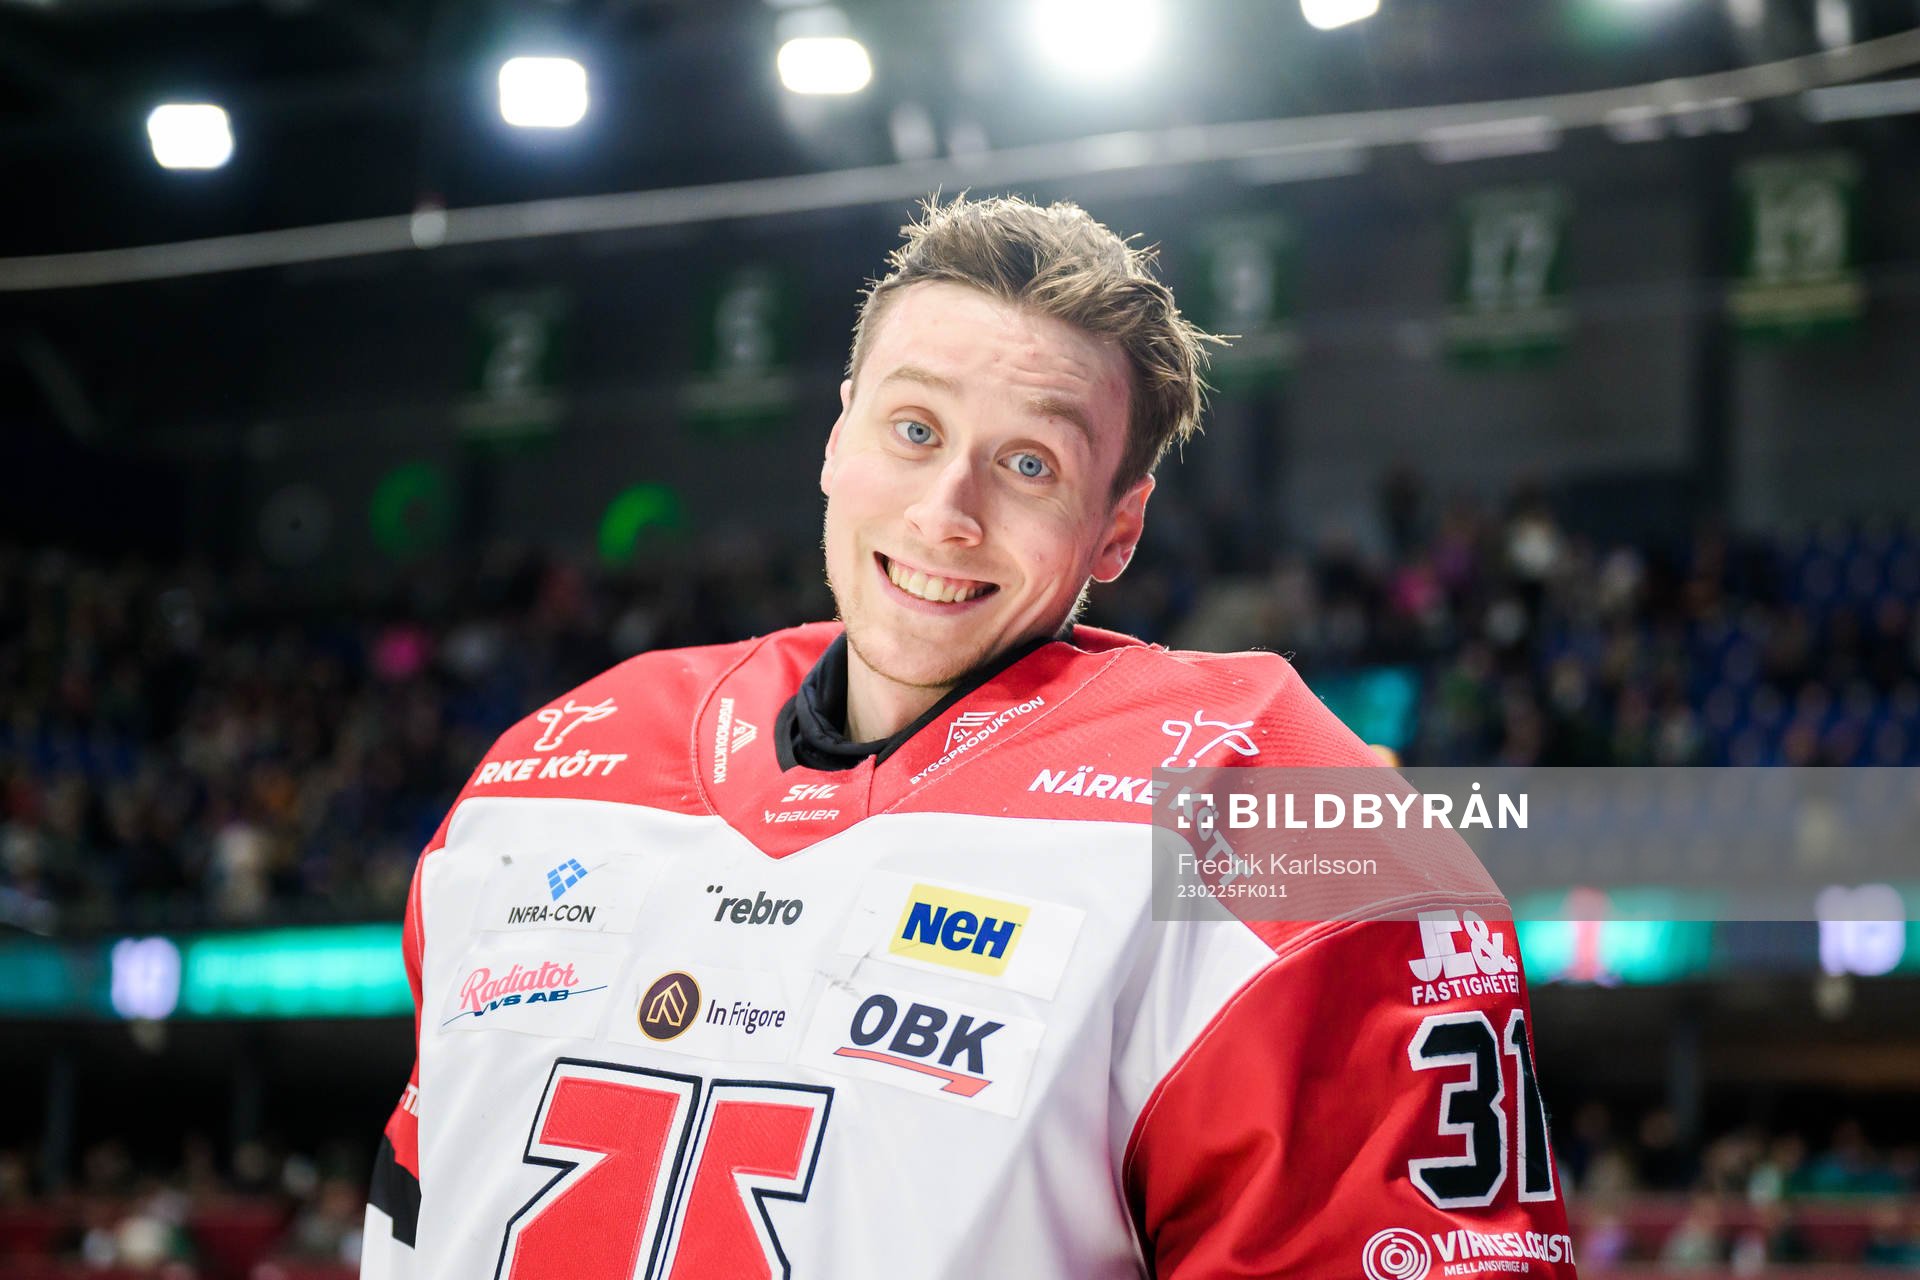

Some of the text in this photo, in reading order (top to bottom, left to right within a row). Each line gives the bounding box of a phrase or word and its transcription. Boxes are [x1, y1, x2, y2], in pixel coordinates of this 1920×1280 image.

[910, 695, 1046, 785] BYGGPRODUKTION
[953, 727, 973, 743] SL
[538, 749, 628, 779] KÖTT
[780, 784, 841, 803] SHL
[1028, 766, 1170, 806] NÄRKE
[507, 904, 597, 924] INFRA-CON
[459, 960, 580, 1014] Radiator
[525, 990, 571, 1004] AB
[706, 999, 786, 1035] In Frigore
[850, 994, 1006, 1075] OBK
[1408, 1008, 1556, 1210] 31
[1444, 1260, 1519, 1277] MELLANSVERIGE
